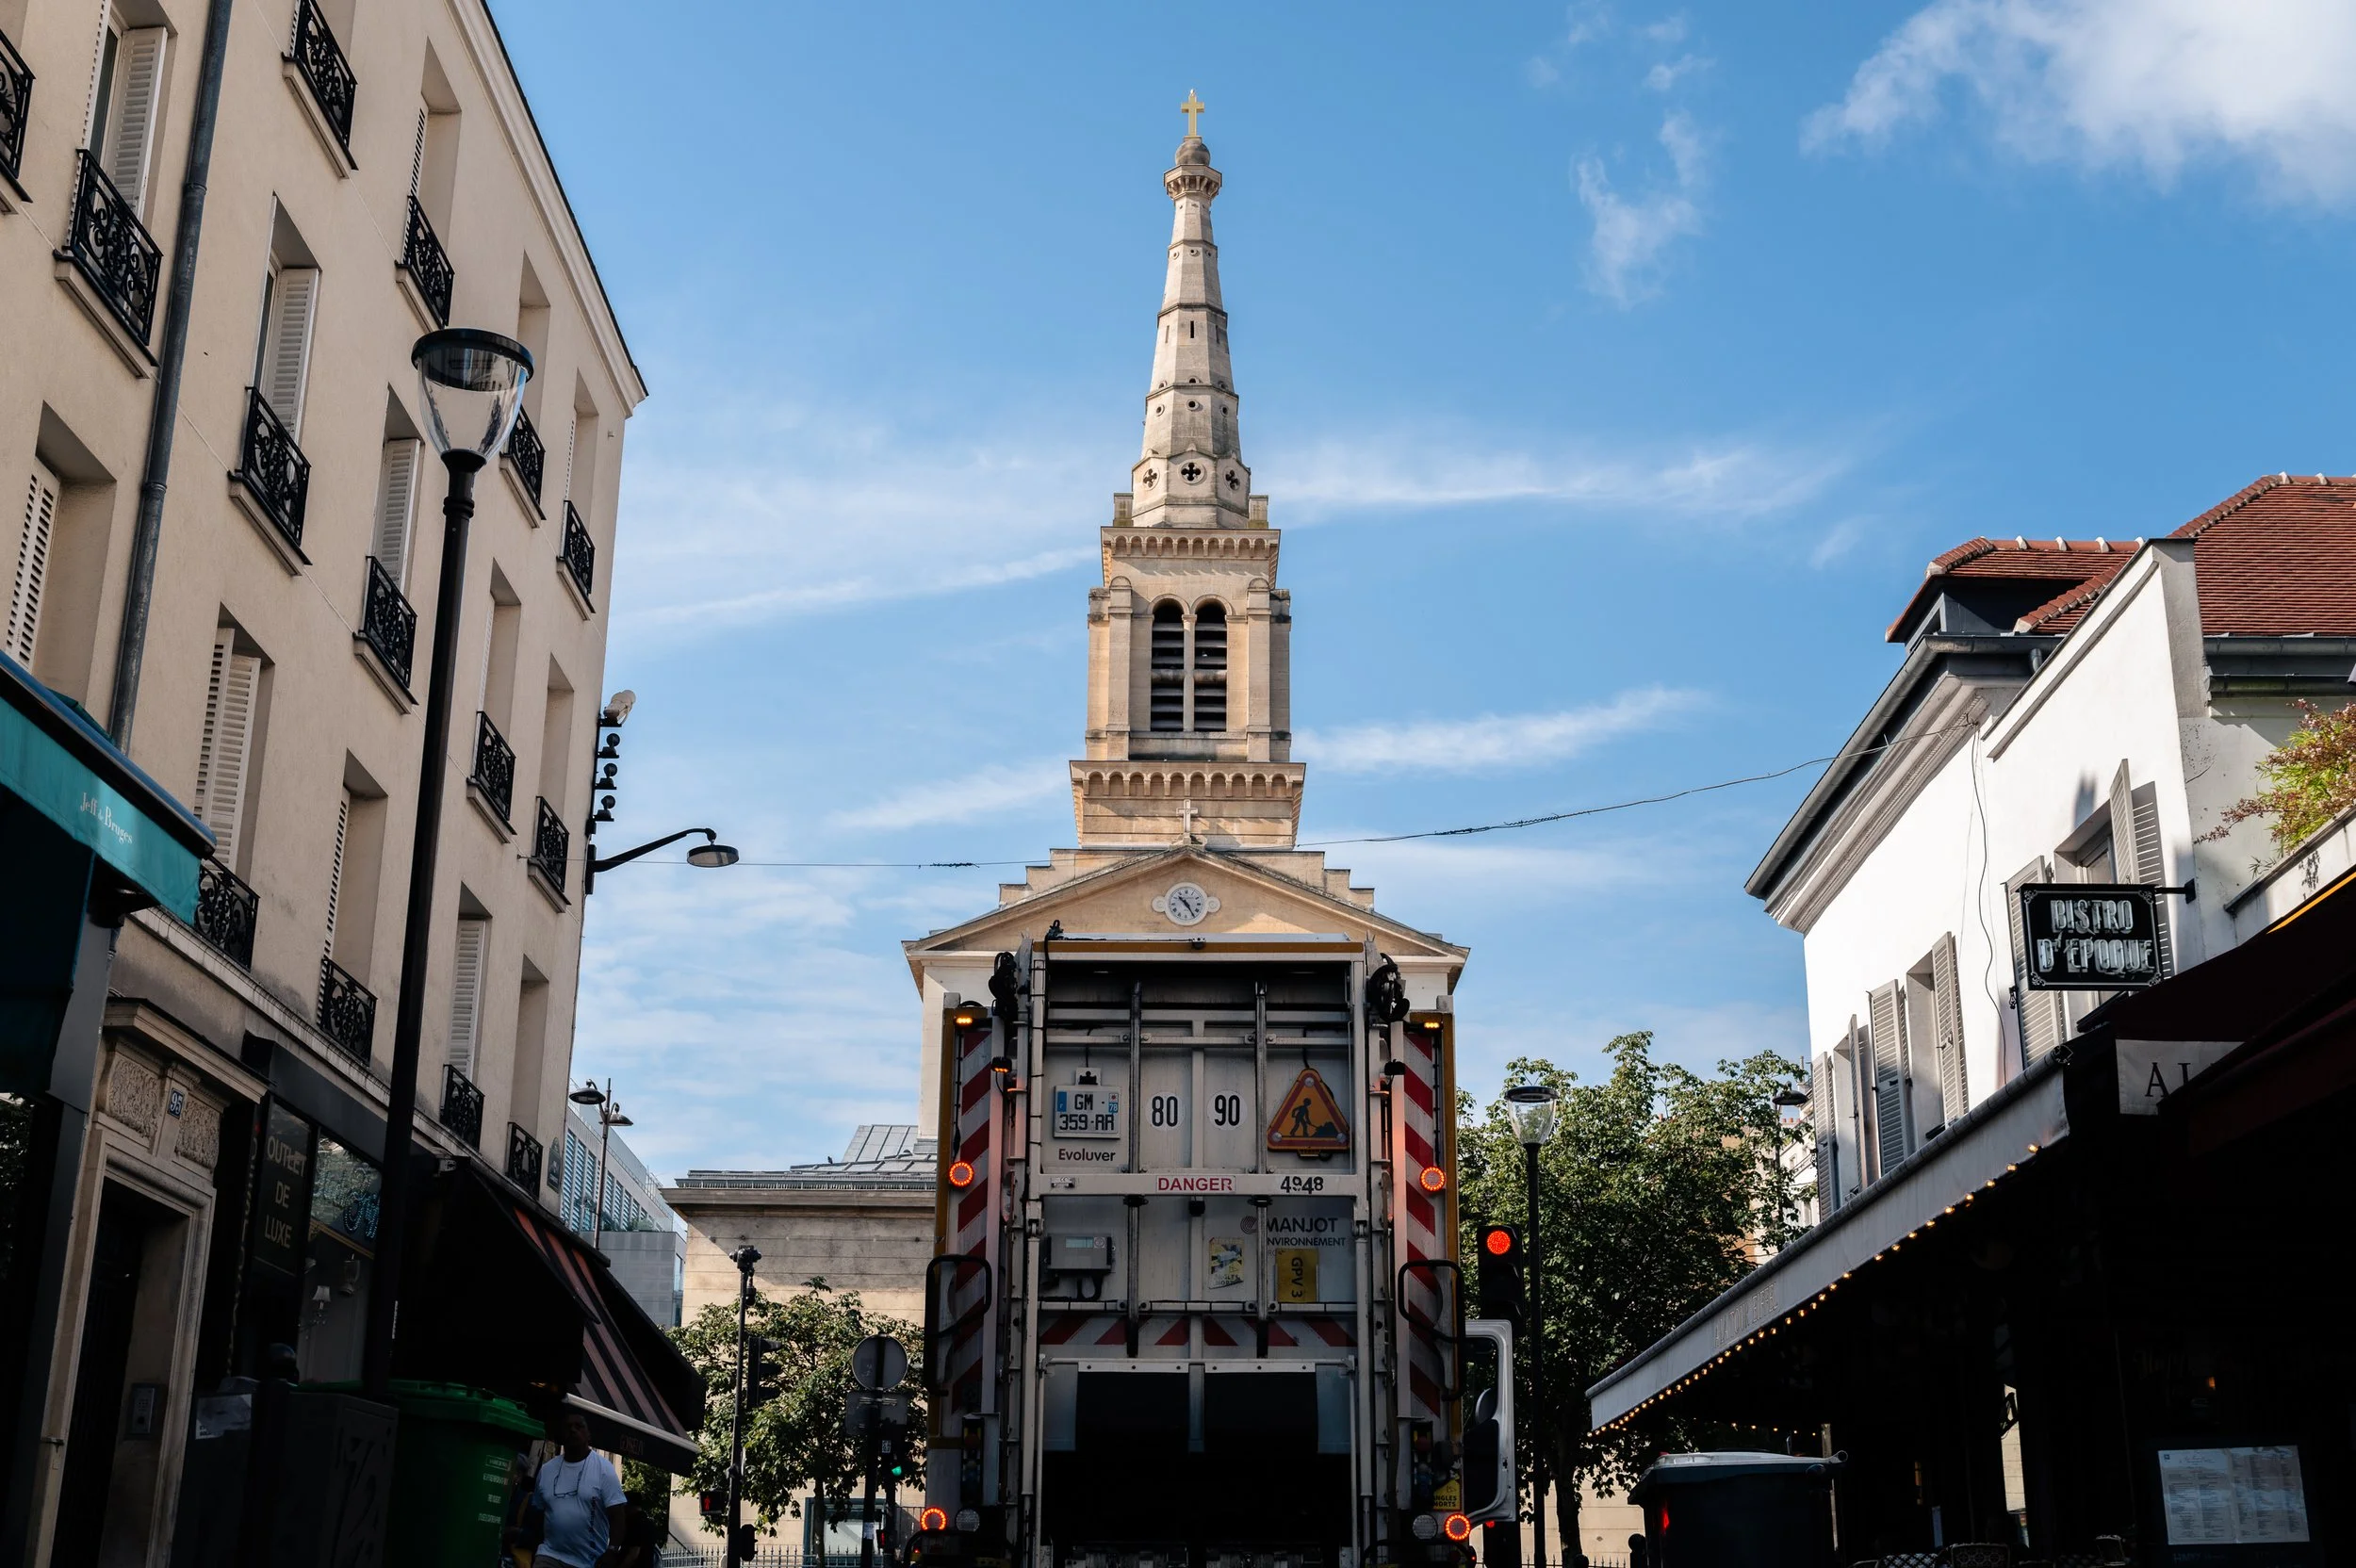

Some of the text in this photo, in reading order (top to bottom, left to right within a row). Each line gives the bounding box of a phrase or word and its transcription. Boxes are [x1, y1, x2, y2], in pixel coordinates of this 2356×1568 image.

[80, 792, 97, 816] Jeff
[104, 806, 133, 844] Bruges
[2050, 899, 2134, 934] BISTRO
[171, 1092, 184, 1115] 95
[1108, 1103, 1118, 1112] 78
[1152, 1095, 1178, 1127] 80
[1214, 1094, 1240, 1126] 90
[268, 1135, 306, 1177] OUTLET
[1058, 1148, 1116, 1161] Evoluver
[275, 1181, 290, 1209] DE
[1158, 1178, 1233, 1191] DANGER
[1280, 1176, 1324, 1194] 4948
[265, 1215, 292, 1249] LUXE
[1267, 1217, 1338, 1233] MANJOT
[1267, 1237, 1346, 1247] NVIRONNEMENT
[1291, 1257, 1303, 1298] GPV 3
